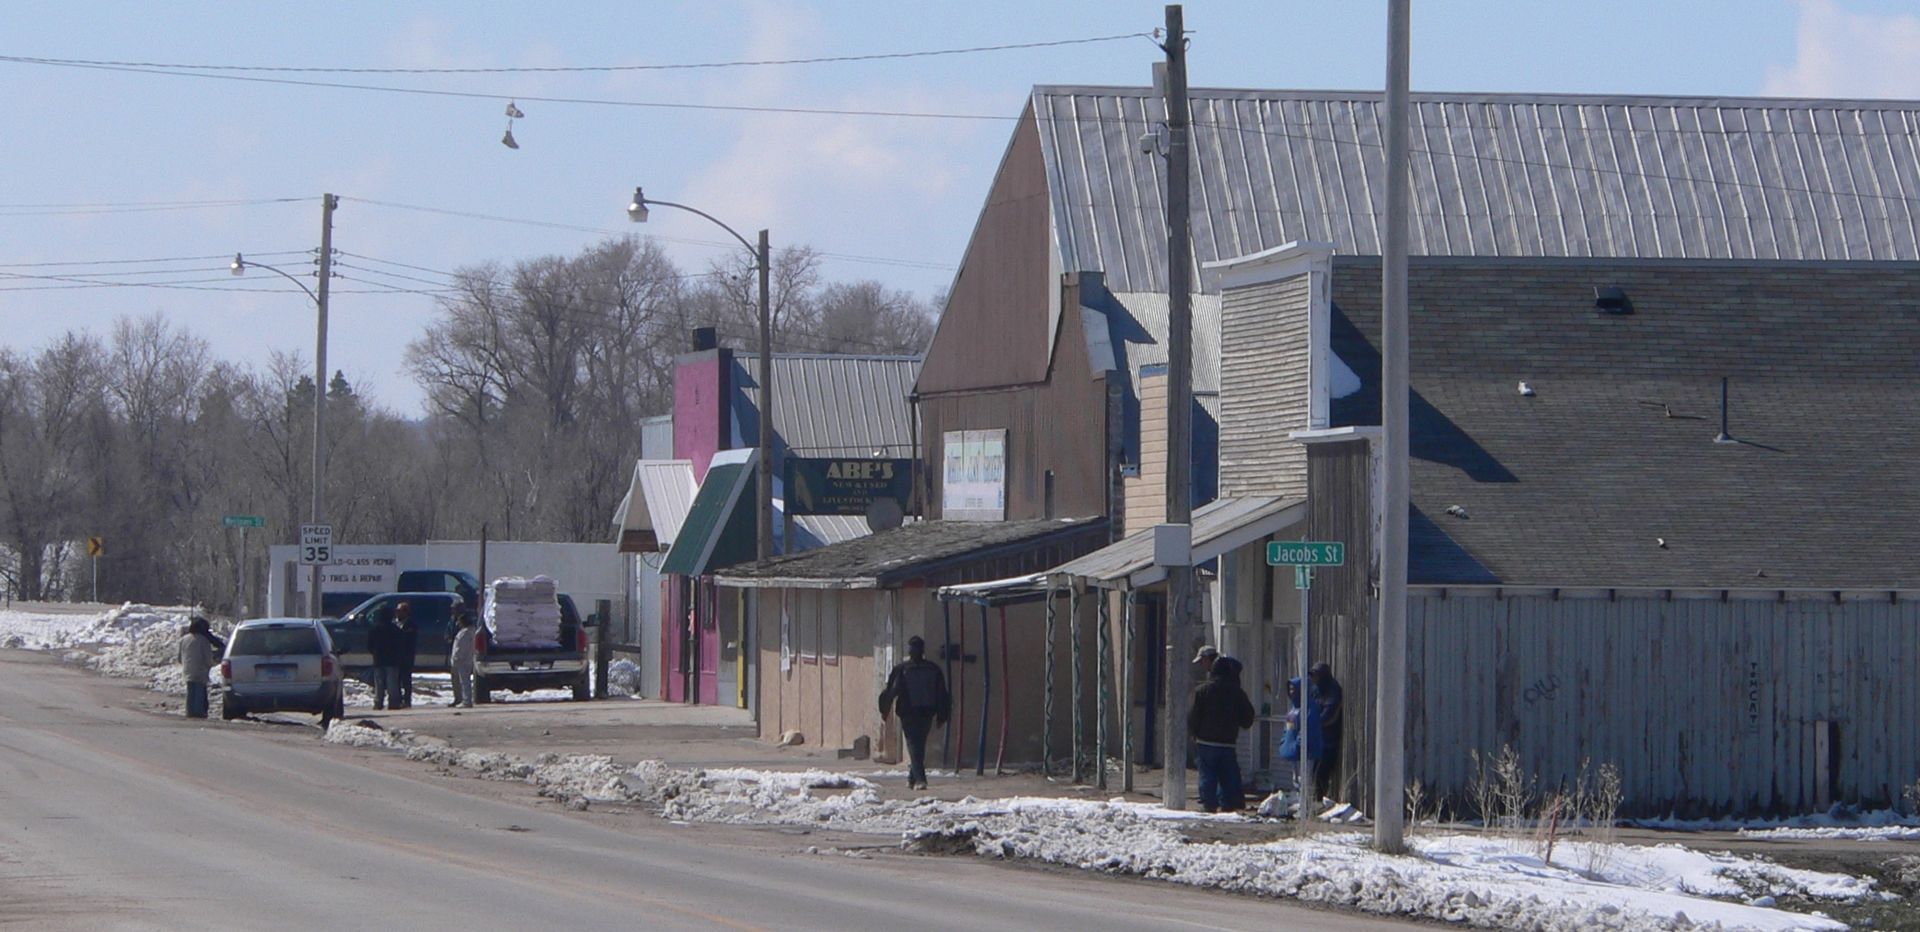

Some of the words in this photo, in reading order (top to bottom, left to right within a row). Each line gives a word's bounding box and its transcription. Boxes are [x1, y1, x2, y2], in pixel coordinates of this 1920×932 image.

[826, 462, 894, 479] ABE'S
[303, 527, 331, 536] SPEED
[305, 537, 328, 545] LIMIT
[305, 546, 329, 562] 35
[1273, 545, 1319, 562] Jacobs
[1325, 545, 1338, 562] St
